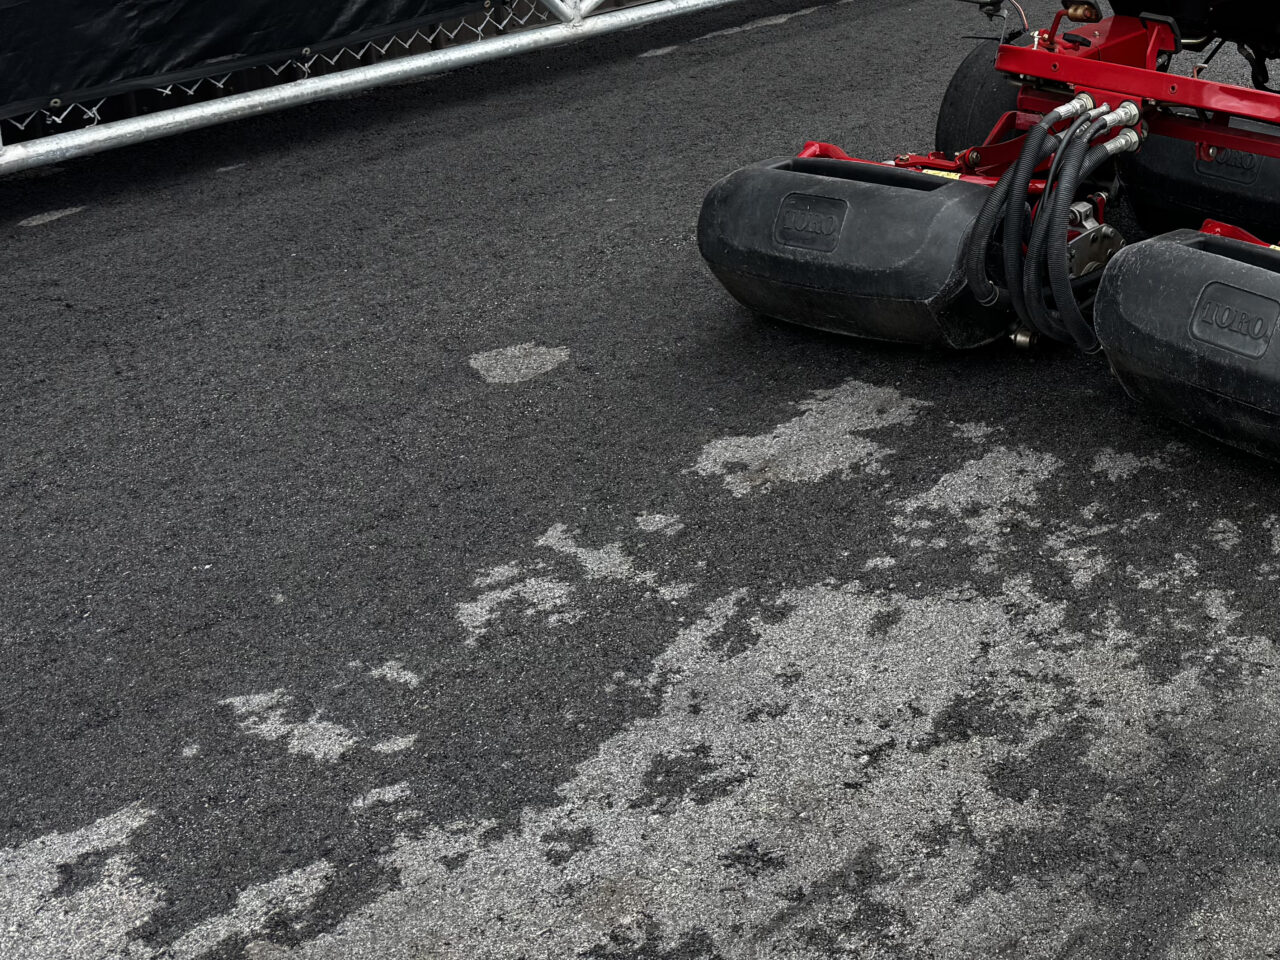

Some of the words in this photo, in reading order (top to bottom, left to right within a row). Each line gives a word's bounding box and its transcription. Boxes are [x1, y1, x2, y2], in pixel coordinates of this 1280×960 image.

[1215, 146, 1257, 170] ORO
[783, 208, 837, 237] TORO
[1201, 301, 1270, 340] TORO
